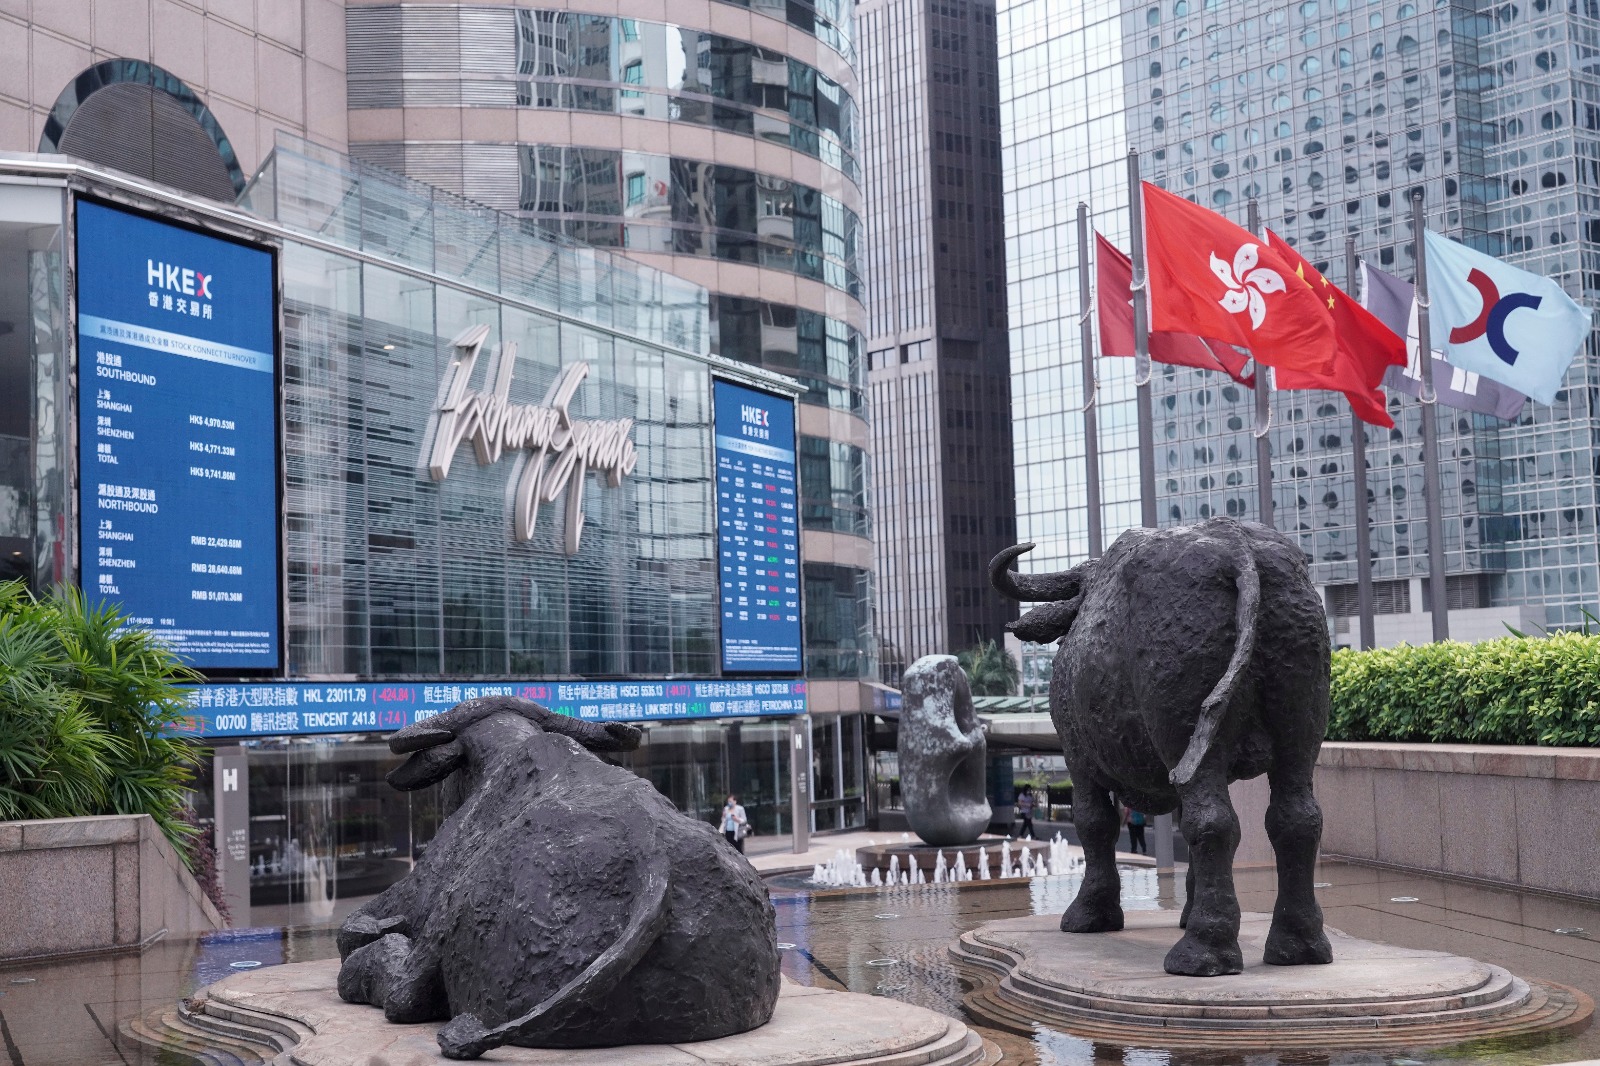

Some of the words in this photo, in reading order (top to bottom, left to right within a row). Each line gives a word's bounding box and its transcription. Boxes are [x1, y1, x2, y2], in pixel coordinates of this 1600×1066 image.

[147, 259, 212, 300] HKEX
[149, 292, 212, 320] 香港交易所
[171, 336, 191, 350] STOCK
[193, 341, 222, 358] CONNECT
[224, 350, 256, 365] TURNOVER
[96, 351, 122, 368] 港股通
[96, 366, 157, 386] SOUTHBOUND
[97, 388, 112, 401] 上海
[96, 399, 133, 413] SHANGHAI
[189, 414, 203, 426] HK$
[204, 417, 235, 430] 4,970.53M
[741, 404, 769, 427] HKEX
[97, 426, 135, 440] SHENZHEN
[189, 441, 203, 452] HK$
[204, 443, 236, 456] 4,771.33M
[97, 454, 119, 465] TOTAL
[190, 466, 204, 478] HK$
[98, 498, 159, 514] NORTHBOUND
[98, 519, 113, 531] 上海
[98, 530, 134, 542] SHANGHAI
[191, 535, 207, 546] RMB
[98, 557, 136, 569] SHENZHEN
[191, 563, 207, 573] RMB
[99, 584, 120, 595] TOTAL
[191, 590, 207, 600] RMB
[303, 688, 323, 703] HKL
[326, 688, 367, 702] 23011.79
[464, 687, 478, 700] HSI
[215, 714, 247, 730] 00700
[302, 711, 349, 727] TENCENT
[352, 711, 376, 726] 241.8
[222, 768, 238, 792] H
